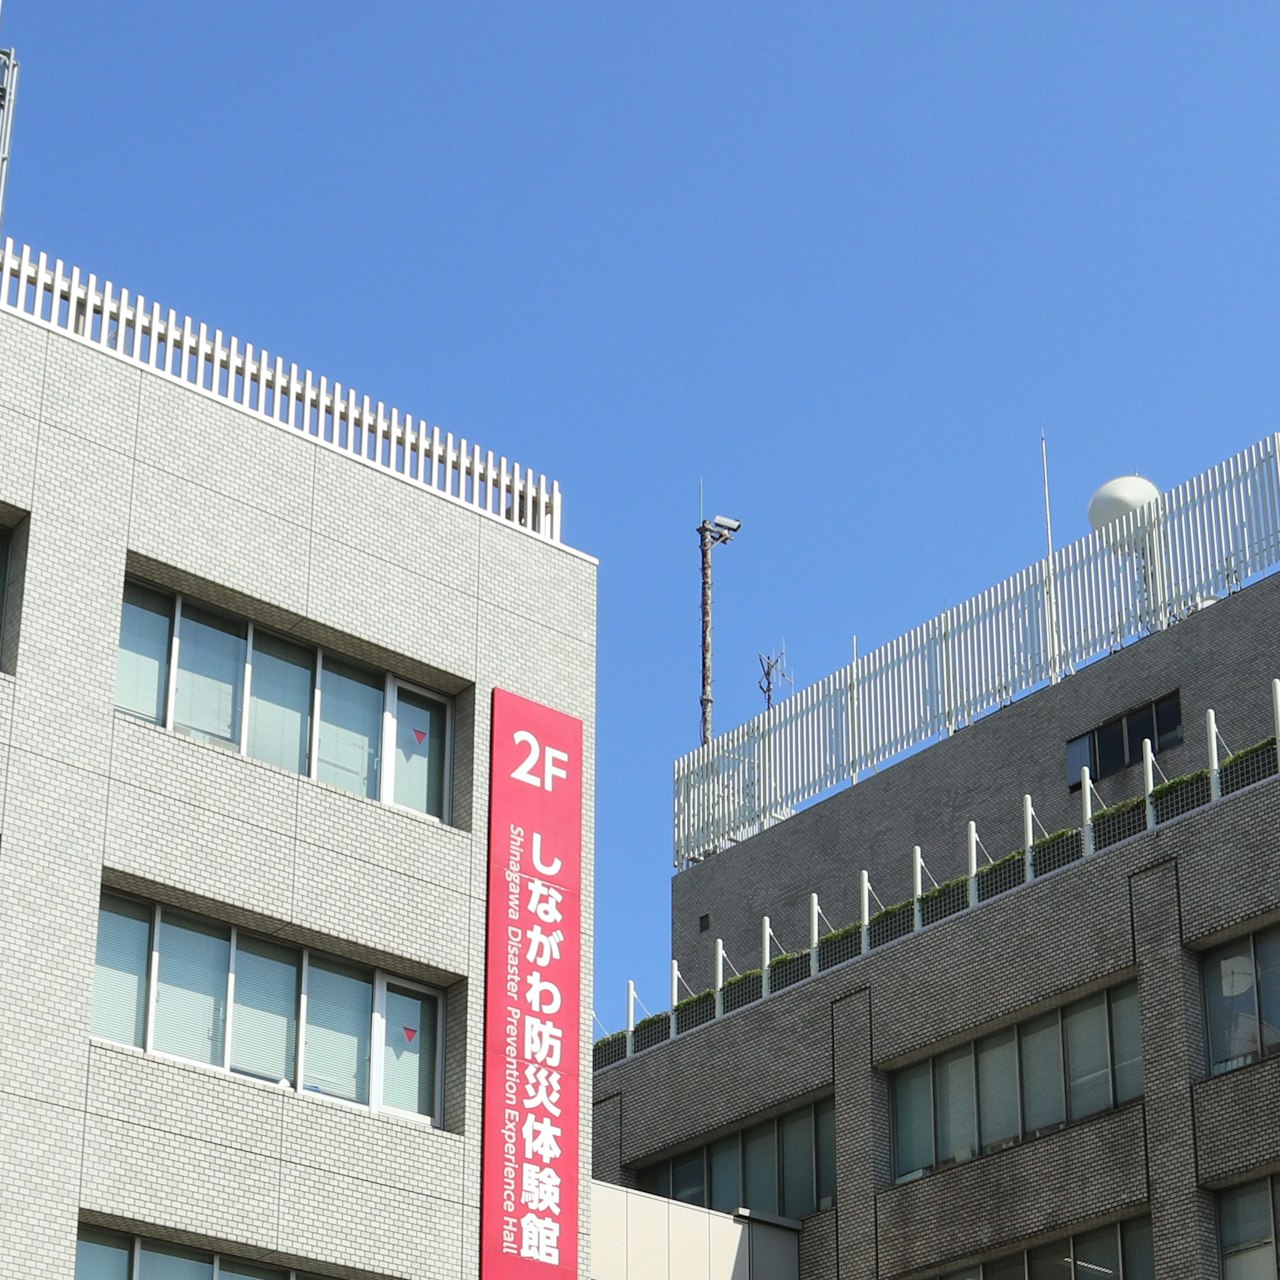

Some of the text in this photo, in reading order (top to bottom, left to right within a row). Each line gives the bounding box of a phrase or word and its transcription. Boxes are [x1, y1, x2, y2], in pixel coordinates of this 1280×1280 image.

[510, 730, 568, 792] 2F
[500, 823, 524, 1254] Shinagawa Disaster Prevention Experience Hall
[520, 832, 564, 1266] しながわ防災体験館
